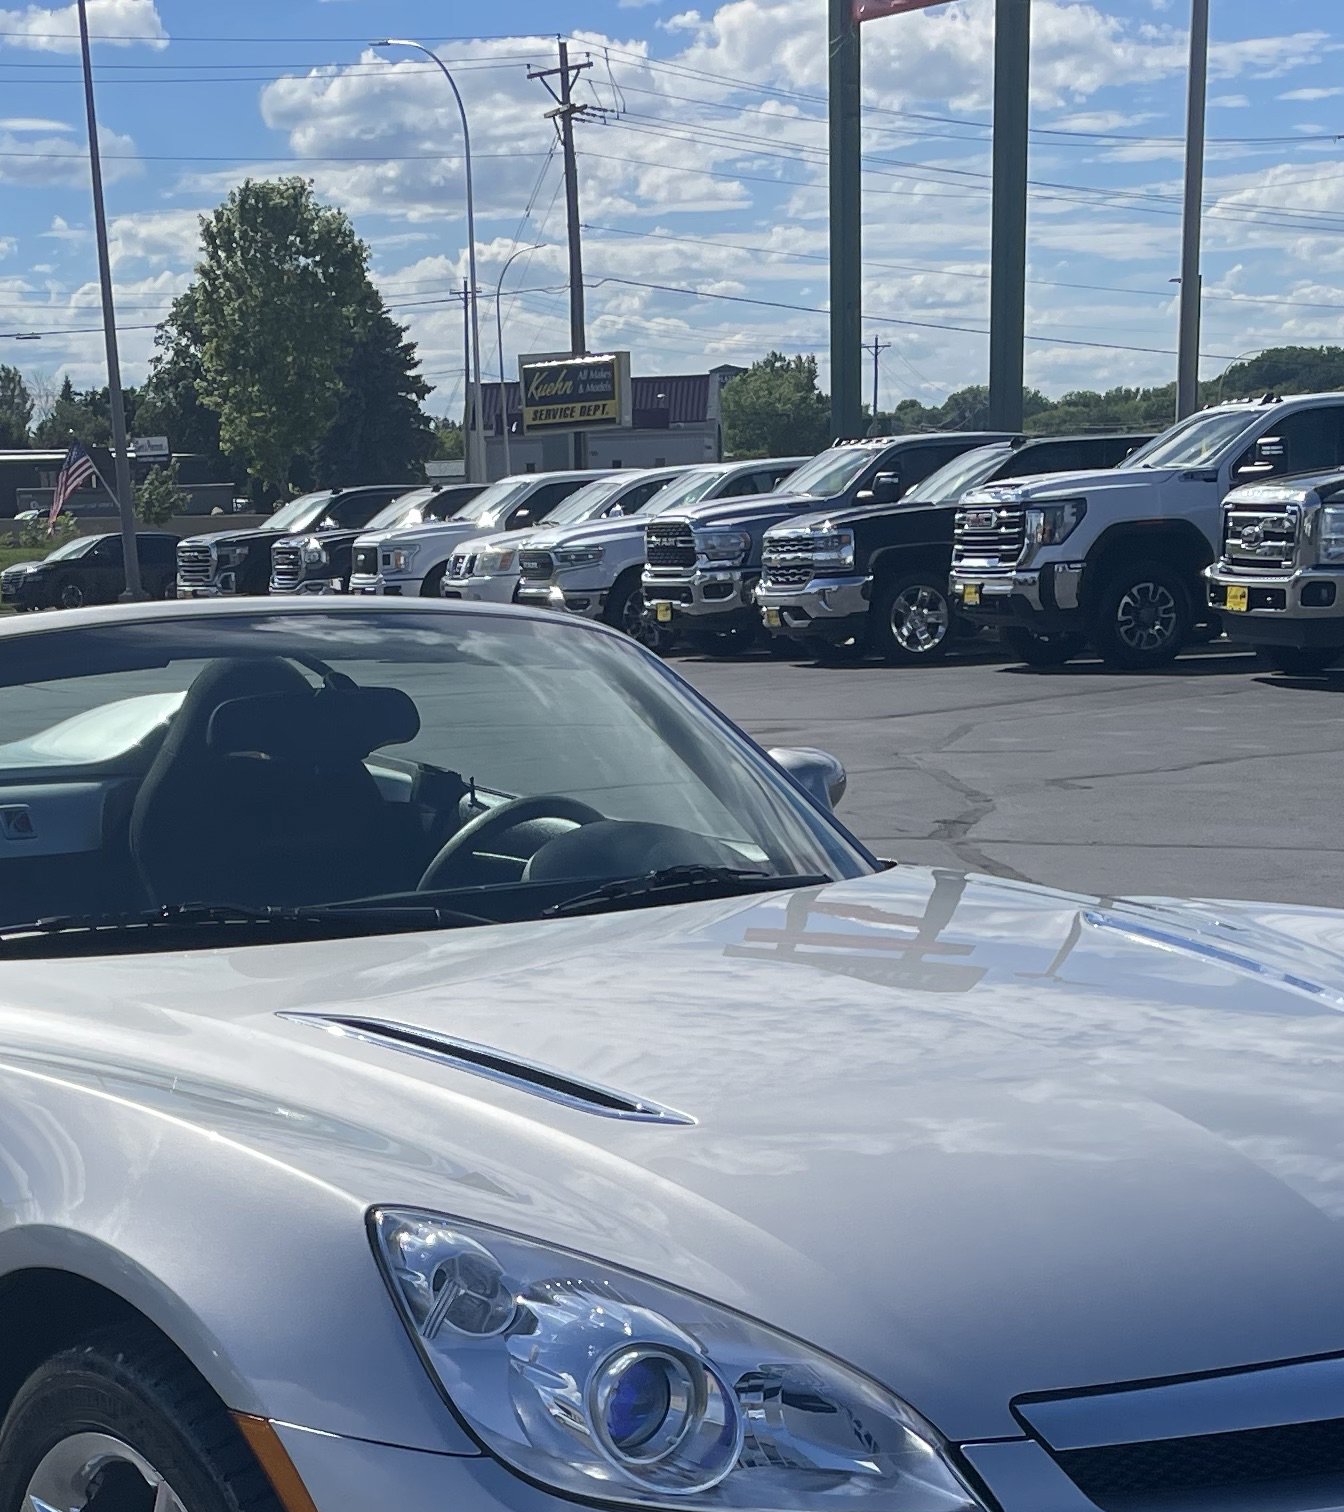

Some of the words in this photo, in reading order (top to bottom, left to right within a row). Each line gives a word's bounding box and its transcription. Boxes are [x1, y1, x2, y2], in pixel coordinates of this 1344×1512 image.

[578, 368, 588, 380] All
[590, 368, 611, 379] Makes
[527, 369, 574, 400] Kuehn
[578, 383, 584, 393] &
[586, 381, 612, 392] Models
[532, 406, 576, 421] SERVICE
[579, 404, 609, 417] DEPT.
